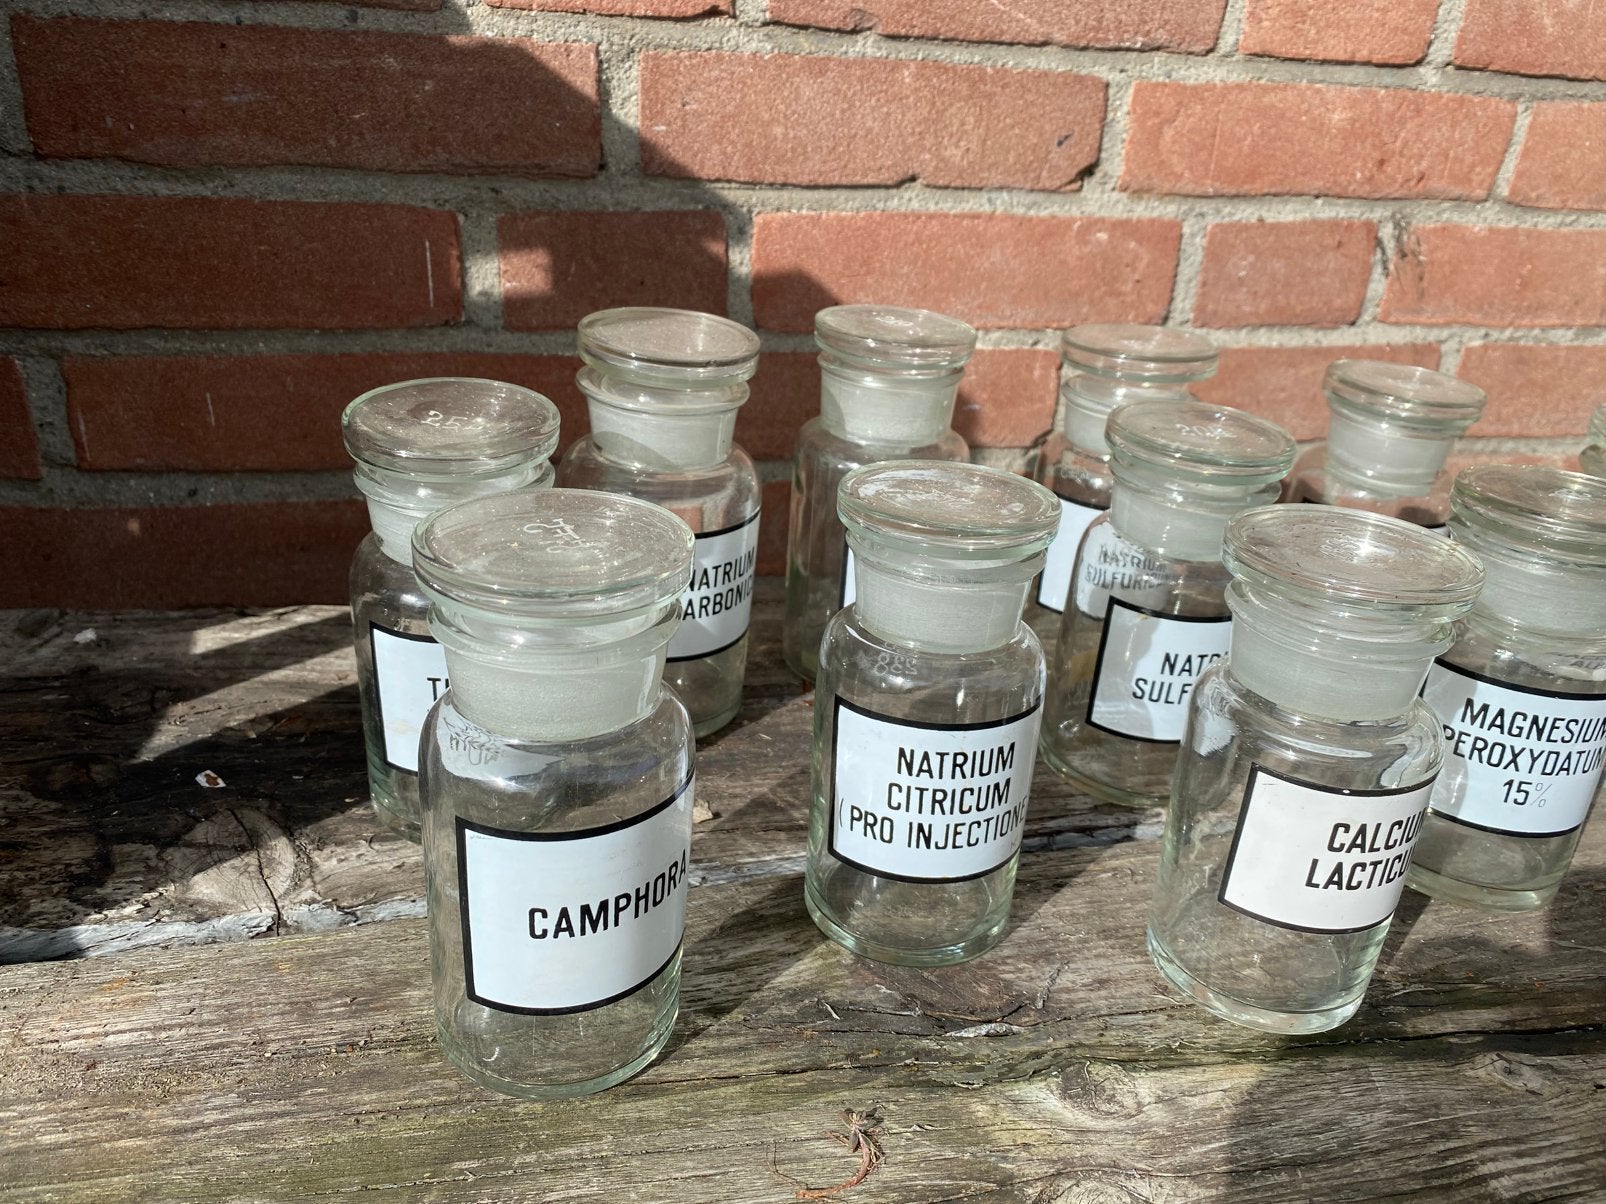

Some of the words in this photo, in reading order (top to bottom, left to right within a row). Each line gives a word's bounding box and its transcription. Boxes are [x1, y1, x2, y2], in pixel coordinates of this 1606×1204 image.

[682, 574, 753, 621] ARBONIC
[897, 741, 1015, 780] NATRIUM
[887, 777, 1011, 816] CITRICUM
[1502, 778, 1552, 808] 15%
[527, 848, 686, 940] CAMPHORA
